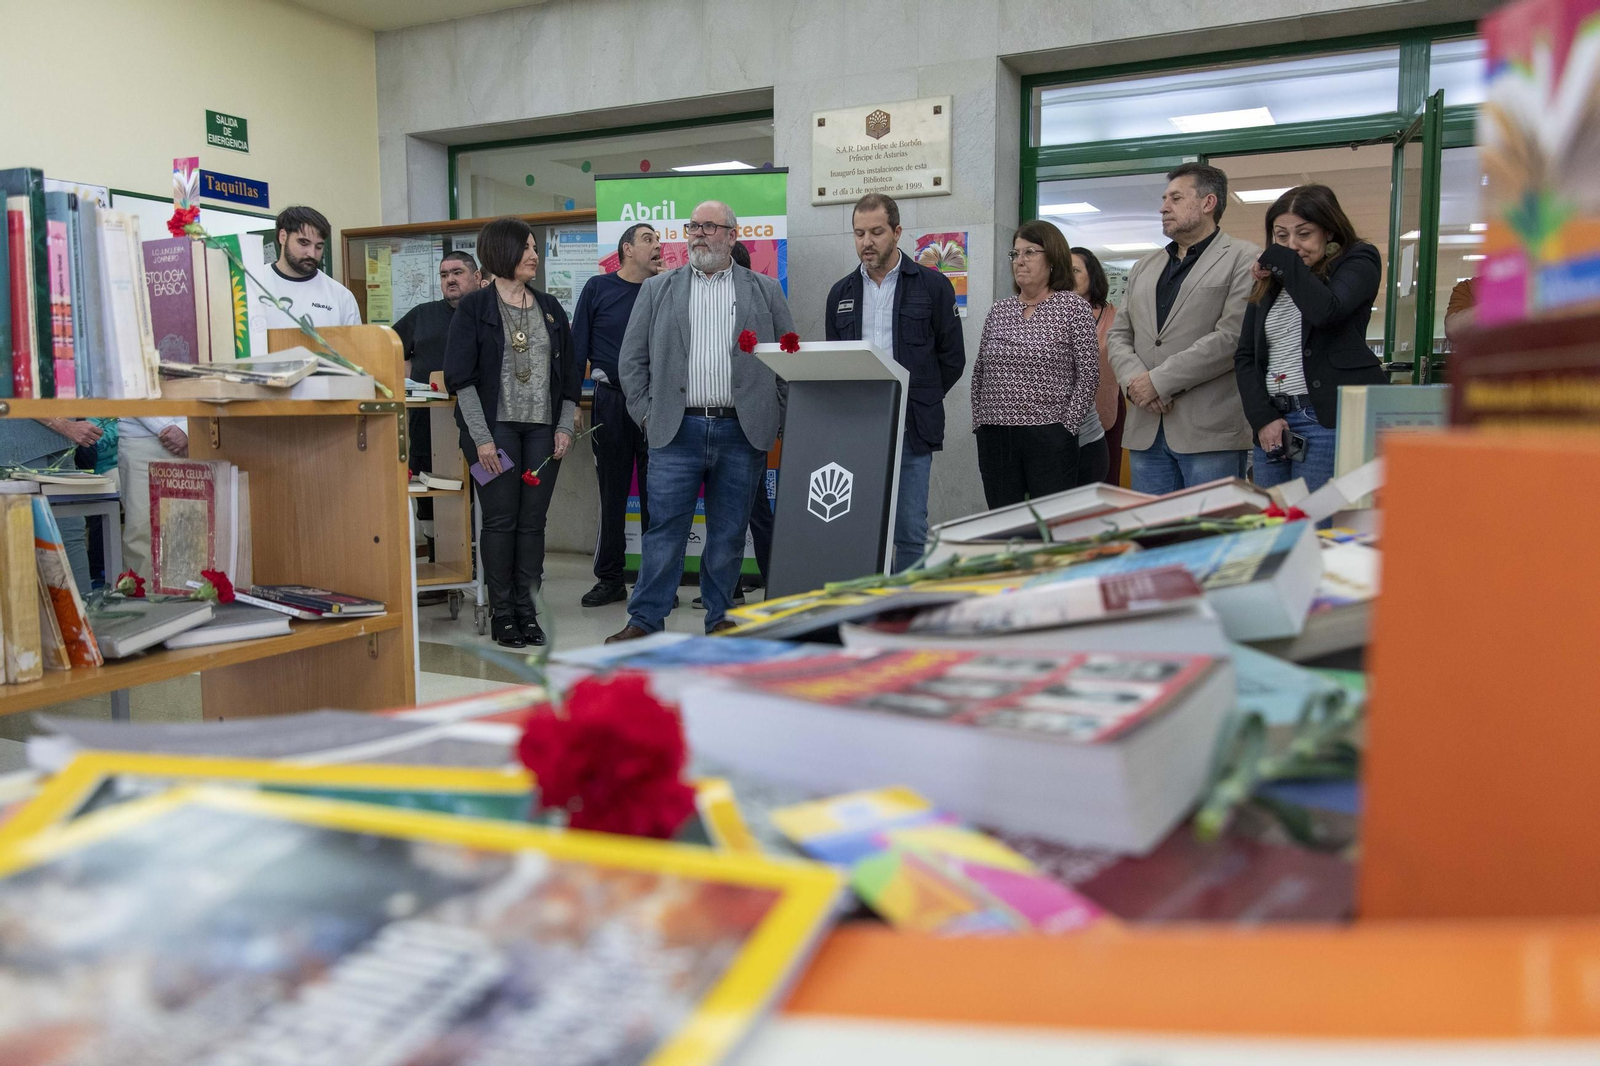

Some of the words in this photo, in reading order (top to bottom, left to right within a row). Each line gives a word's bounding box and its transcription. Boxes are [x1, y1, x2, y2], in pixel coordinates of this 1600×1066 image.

[215, 114, 238, 128] SALIDA
[223, 126, 233, 137] DE
[208, 133, 248, 150] EMERGENCIA
[835, 145, 855, 155] S.A.R.
[856, 144, 869, 152] Don
[871, 142, 888, 151] Felipe
[889, 141, 898, 149] de
[899, 138, 922, 148] Borbón
[848, 153, 874, 162] Príncipe
[874, 152, 882, 160] de
[883, 150, 909, 159] Asturias
[830, 168, 856, 179] Inauguró
[866, 165, 905, 174] instalaciones
[905, 163, 914, 171] de
[914, 162, 928, 170] esta
[204, 174, 259, 199] Taquillas
[863, 175, 893, 184] Biblioteca
[832, 188, 838, 196] el
[838, 187, 849, 195] día
[849, 187, 855, 195] 3
[855, 186, 863, 194] de
[864, 184, 895, 194] noviembre
[895, 183, 904, 191] de
[620, 200, 676, 221] Abril
[665, 226, 678, 240] la
[150, 467, 185, 480] BIOLOGIA
[185, 468, 213, 480] CELULAR
[160, 478, 166, 488] Y
[166, 478, 206, 490] MOLECULAR
